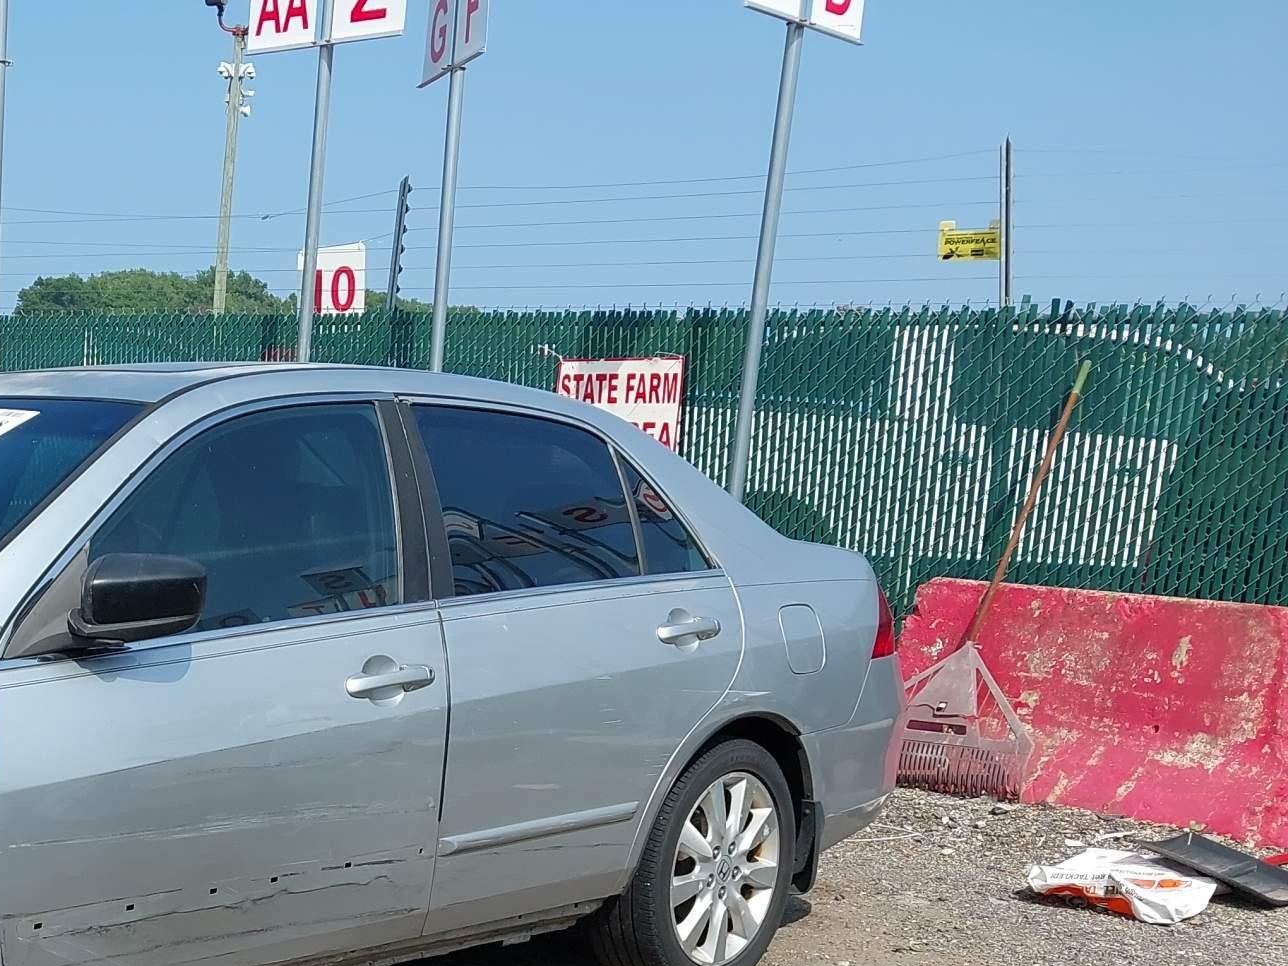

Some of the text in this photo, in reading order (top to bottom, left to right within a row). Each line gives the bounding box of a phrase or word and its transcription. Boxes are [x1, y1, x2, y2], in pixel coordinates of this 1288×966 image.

[430, 0, 448, 63] G
[314, 266, 356, 314] 10
[562, 373, 679, 404] STATE FARM
